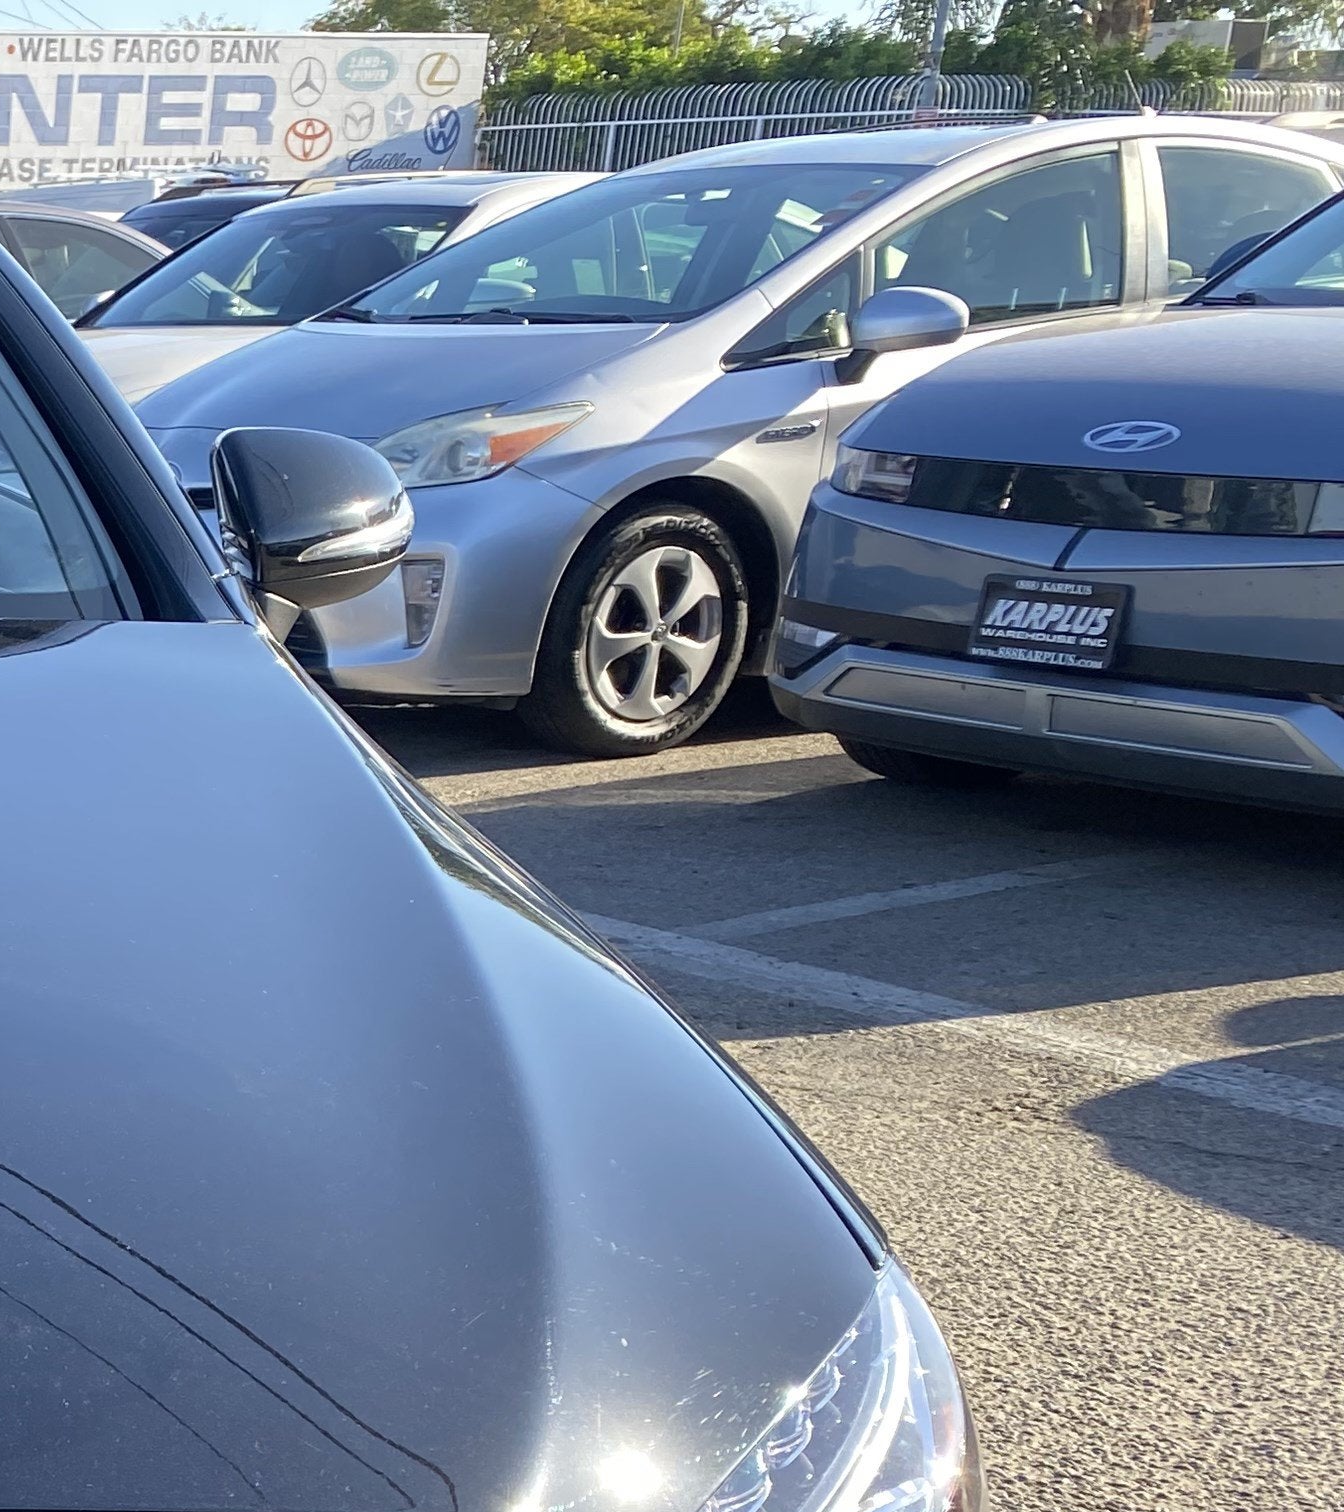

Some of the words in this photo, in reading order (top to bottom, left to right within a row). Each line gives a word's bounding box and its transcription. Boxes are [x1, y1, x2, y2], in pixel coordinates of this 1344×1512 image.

[19, 38, 104, 64] WELLS
[114, 38, 200, 64] FARGO
[212, 39, 281, 65] BANK
[345, 148, 422, 173] Cadillac
[1041, 581, 1093, 596] KARPLUS
[983, 599, 1116, 636] KARPLUS
[981, 627, 1077, 646] WAREHOUSE
[1079, 637, 1109, 648] INC
